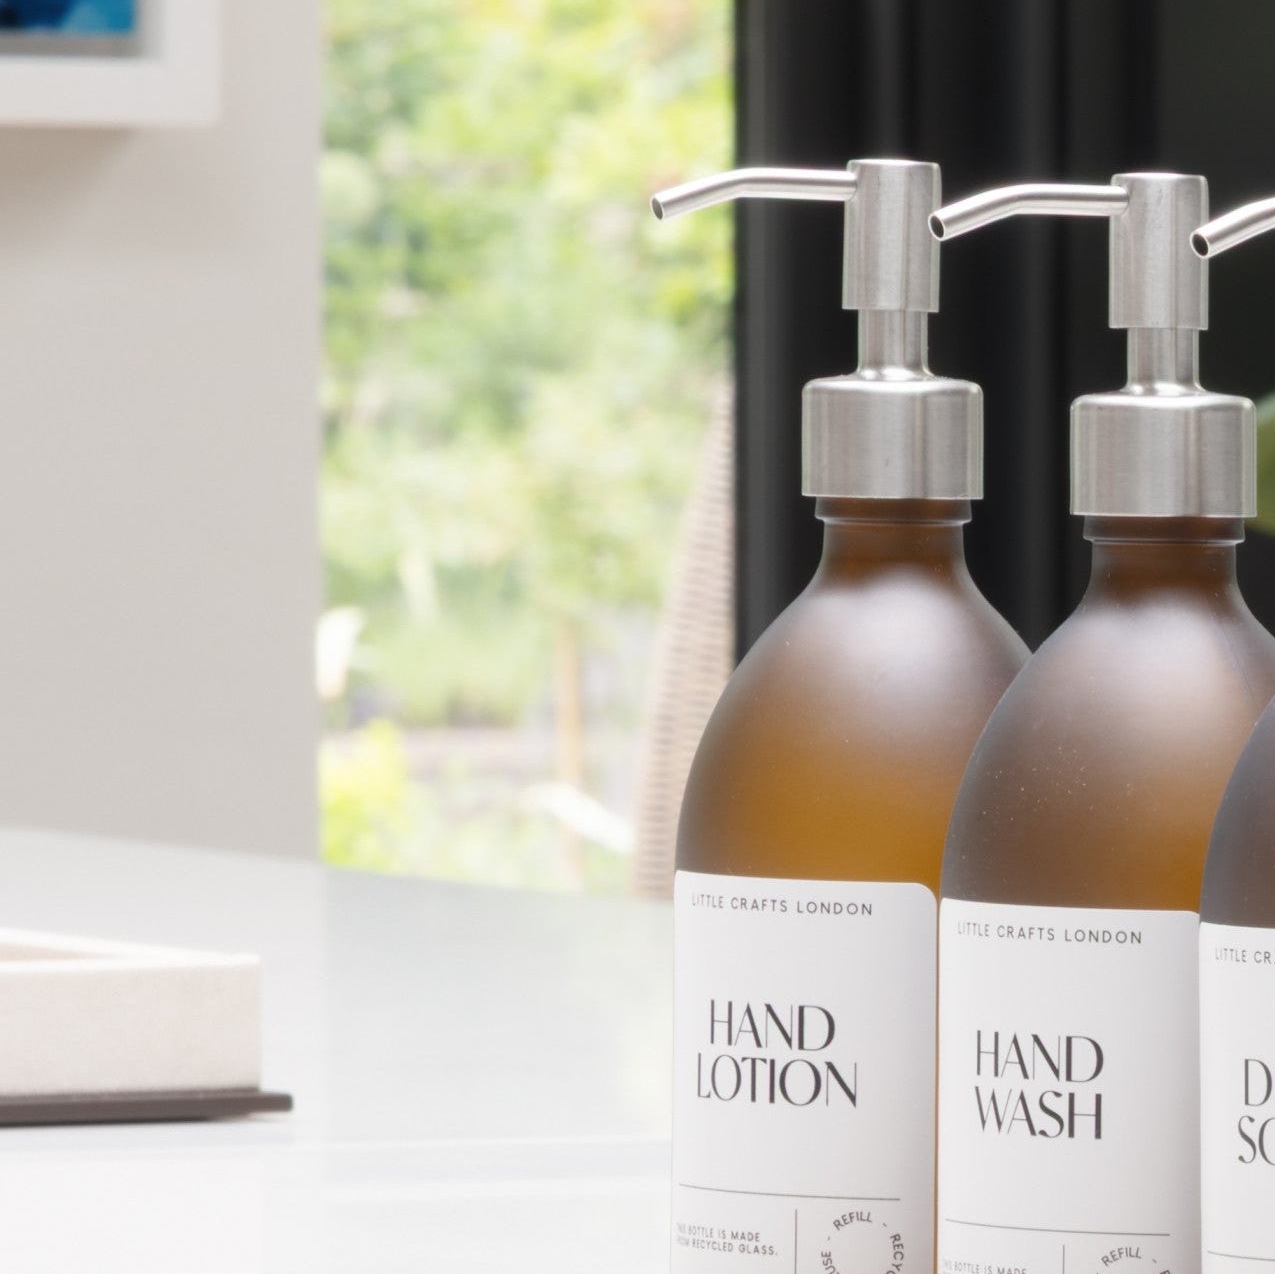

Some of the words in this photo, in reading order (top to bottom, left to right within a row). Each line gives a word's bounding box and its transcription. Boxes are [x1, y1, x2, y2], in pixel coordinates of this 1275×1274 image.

[691, 893, 724, 909] LITTLE
[730, 897, 788, 913] CRAFTS
[797, 901, 872, 916] LONDON
[957, 921, 990, 937] LITTLE
[997, 925, 1055, 941] CRAFTS
[1064, 929, 1142, 944] LONDON
[1214, 946, 1247, 963] LITTLE
[710, 999, 836, 1052] HAND
[977, 1030, 1104, 1083] HAND
[697, 1052, 857, 1108] LOTION
[974, 1085, 1102, 1140] WASH
[833, 1211, 873, 1231] REFILL
[688, 1224, 714, 1238] BOTTLE
[718, 1229, 726, 1239] IS
[731, 1230, 760, 1242] MADE
[692, 1238, 734, 1252] RECYCLED
[738, 1244, 778, 1256] GLASS.
[1101, 1246, 1142, 1267] REFILL
[954, 1261, 980, 1274] BOTTLE
